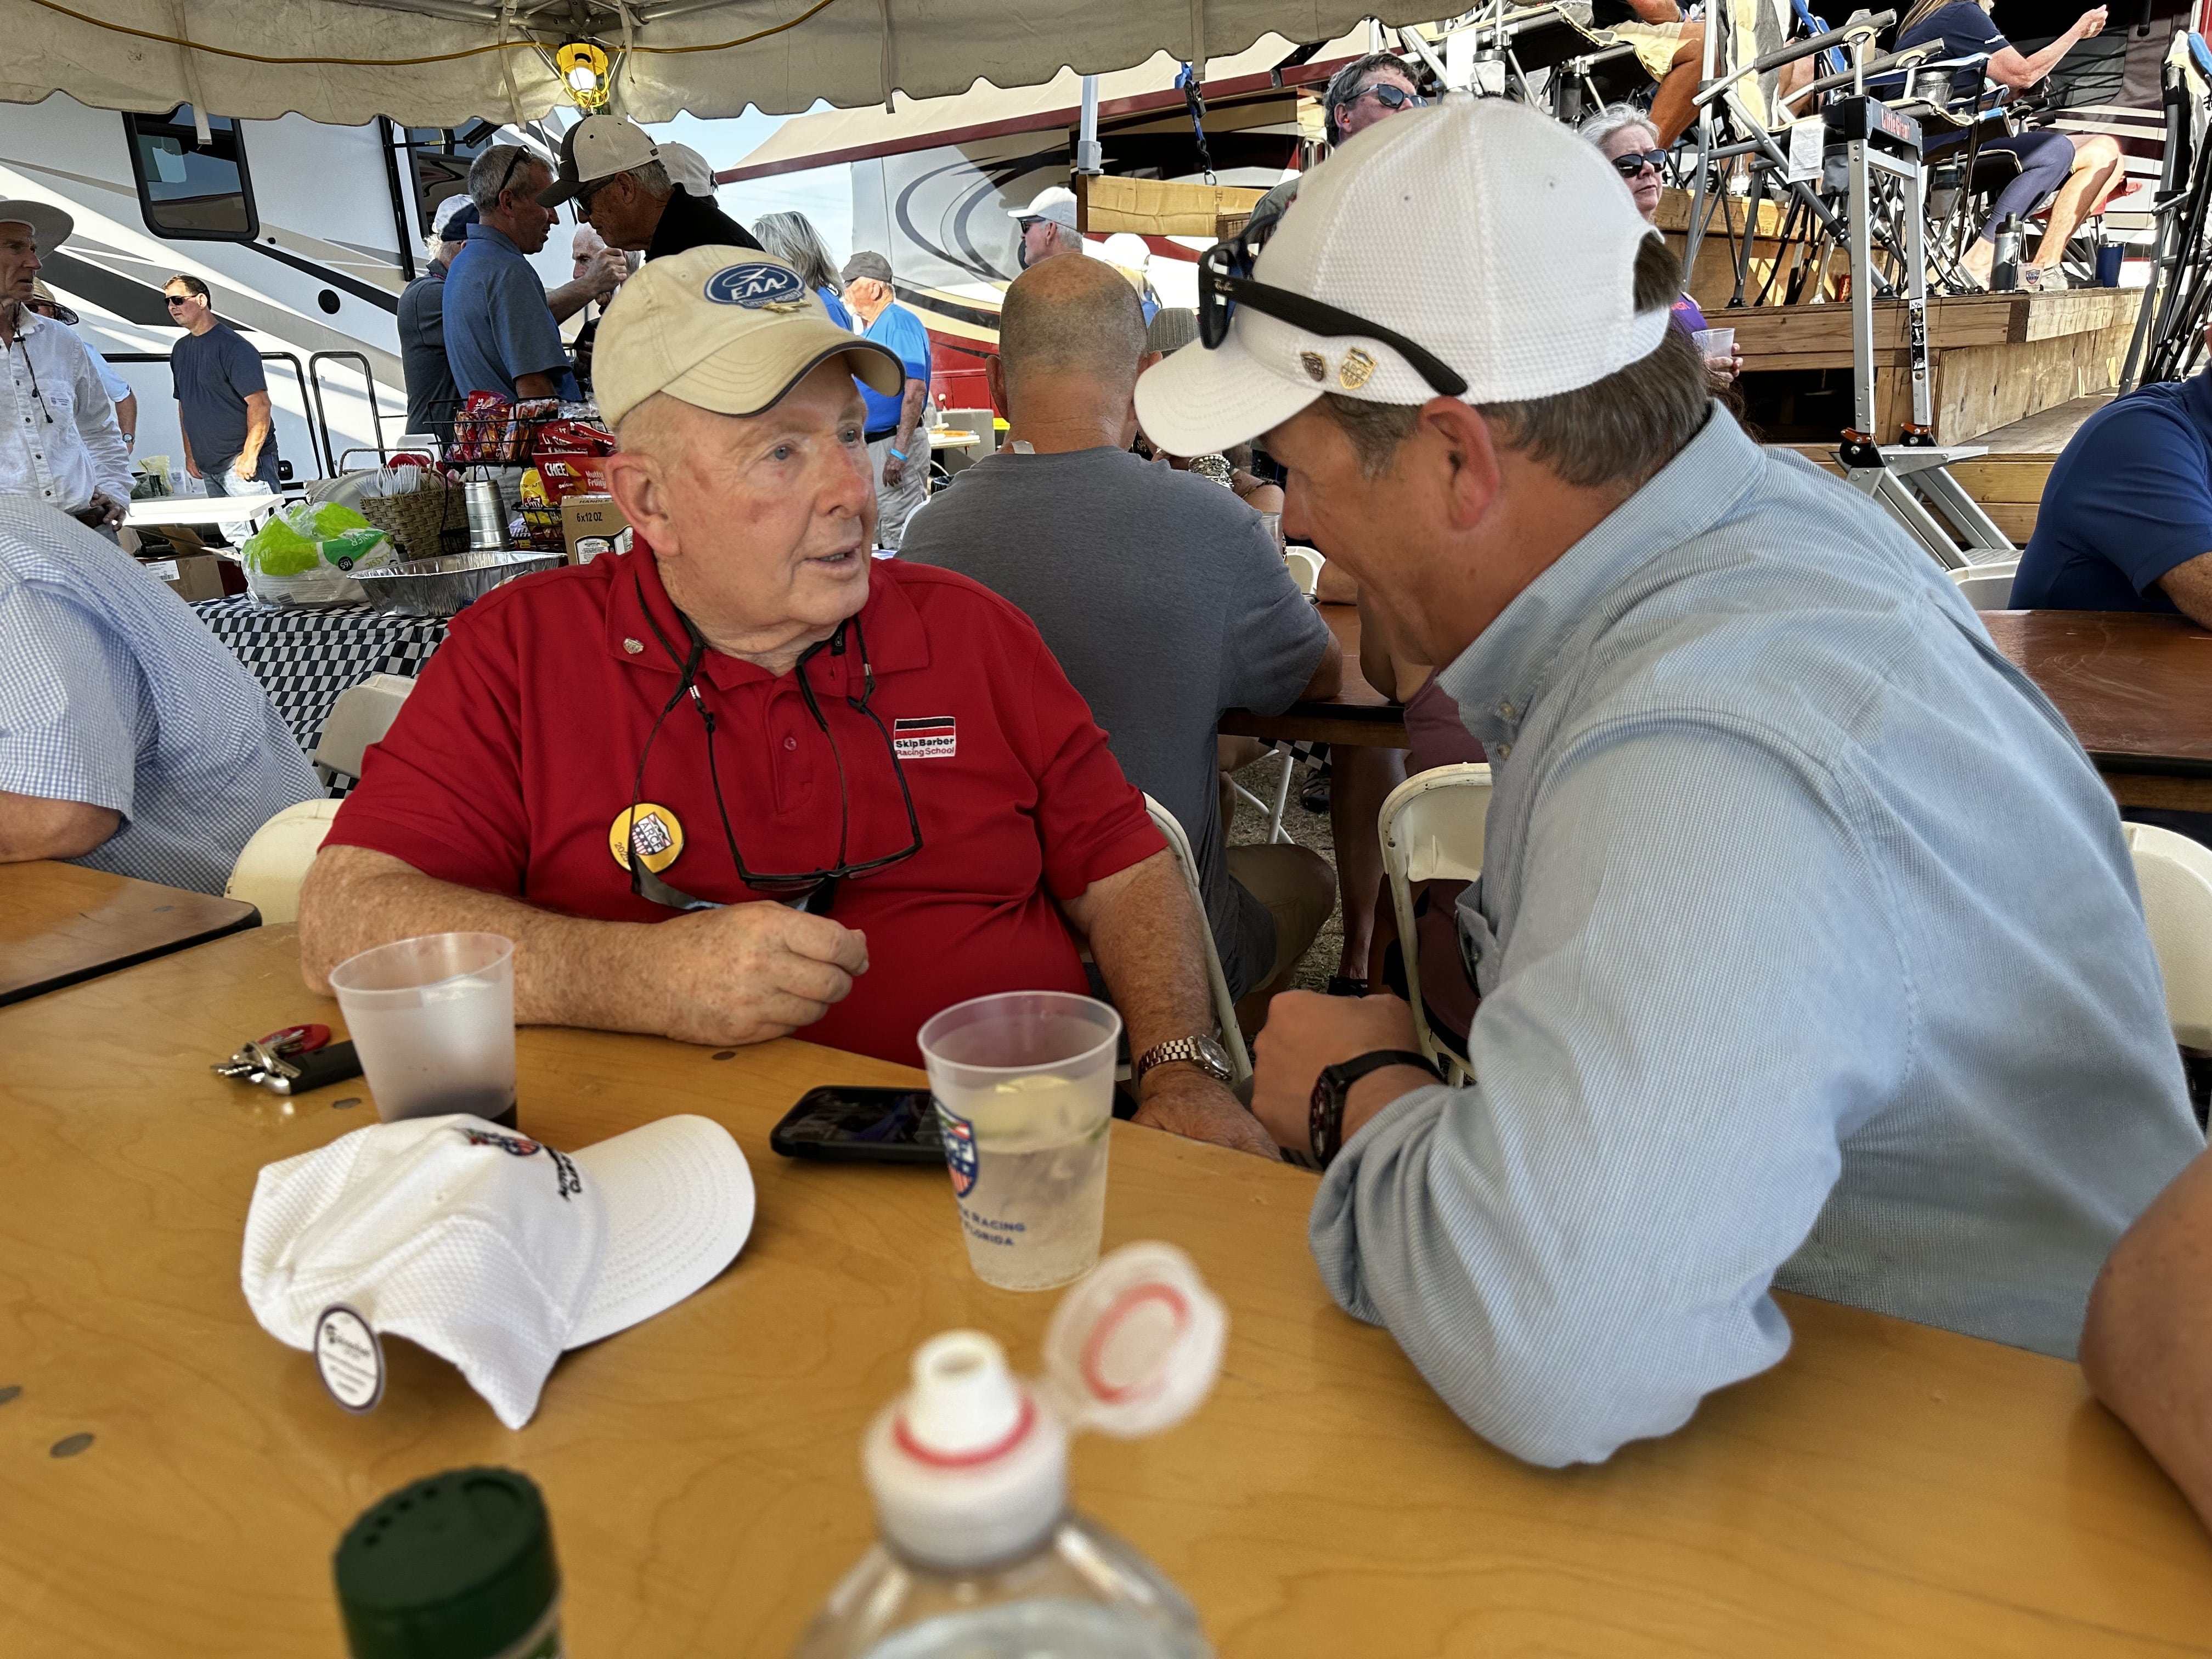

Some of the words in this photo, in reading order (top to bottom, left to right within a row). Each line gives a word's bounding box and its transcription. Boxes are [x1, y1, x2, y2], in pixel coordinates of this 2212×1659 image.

[731, 278, 781, 300] EAA
[545, 462, 569, 477] CHEE
[577, 512, 592, 522] 6x12
[594, 512, 603, 521] OZ
[340, 560, 352, 569] 165
[896, 749, 924, 757] Racing
[925, 747, 954, 755] School
[972, 1211, 1026, 1232] RACING
